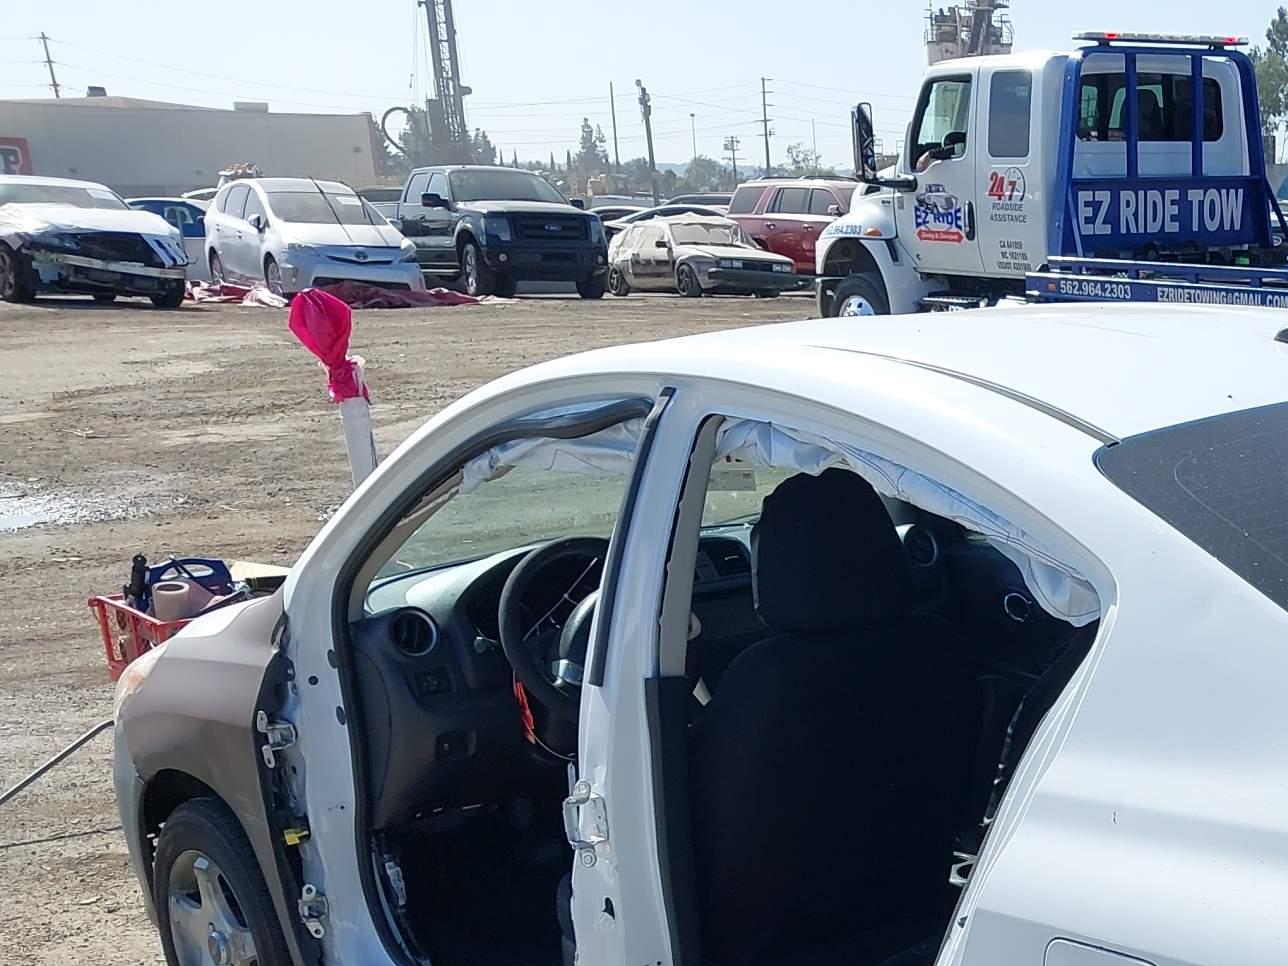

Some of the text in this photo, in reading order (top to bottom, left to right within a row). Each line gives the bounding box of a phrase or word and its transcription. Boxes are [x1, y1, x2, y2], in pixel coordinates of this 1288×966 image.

[992, 202, 1024, 212] ROADSIDE
[1077, 188, 1244, 236] EZ RIDE TOW
[914, 205, 963, 231] EZ RIDE
[989, 214, 1028, 223] ASSISTANCE
[1059, 280, 1131, 300] 562.964.2303
[1156, 286, 1288, 309] EZRIDETOWING@GMAIL.COM
